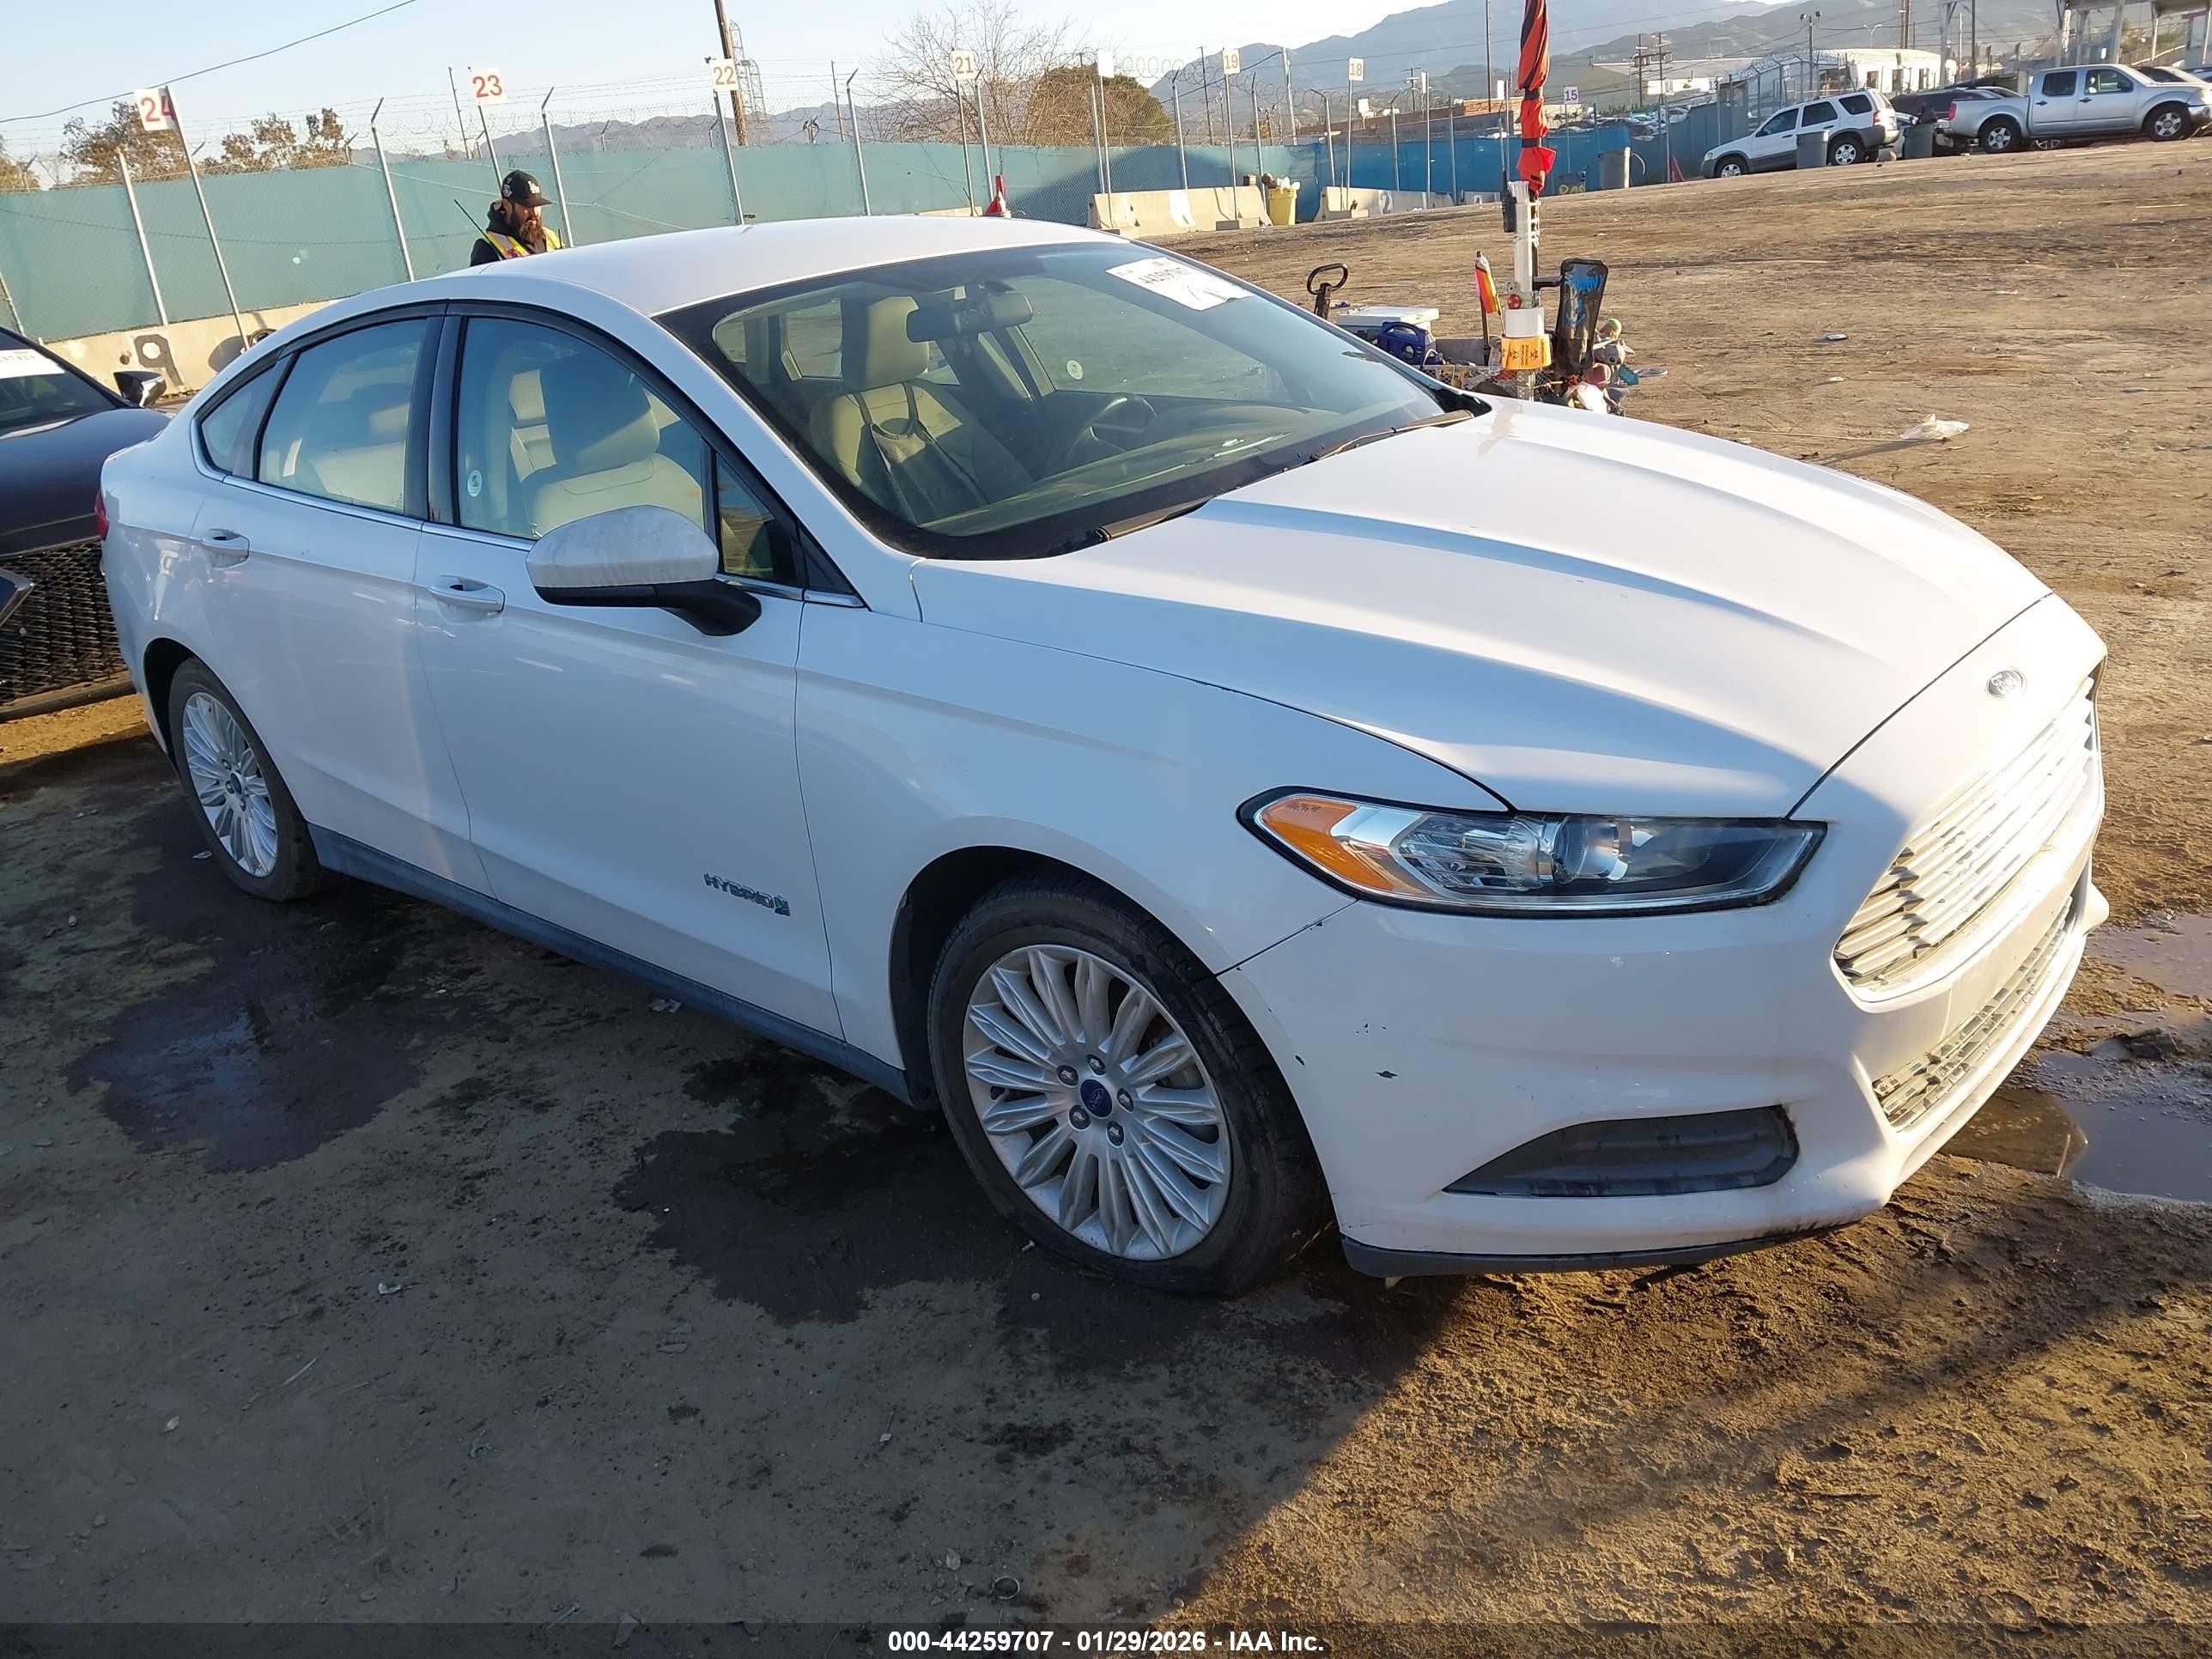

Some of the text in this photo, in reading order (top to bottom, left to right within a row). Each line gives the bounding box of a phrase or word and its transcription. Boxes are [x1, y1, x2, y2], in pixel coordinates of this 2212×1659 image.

[955, 56, 975, 75] 21
[1224, 54, 1238, 69] 19
[1351, 63, 1363, 76] 18
[713, 66, 736, 85] 22
[472, 74, 502, 98] 23
[1565, 89, 1578, 101] 15
[140, 95, 175, 122] 24
[703, 872, 775, 908] HYBRID
